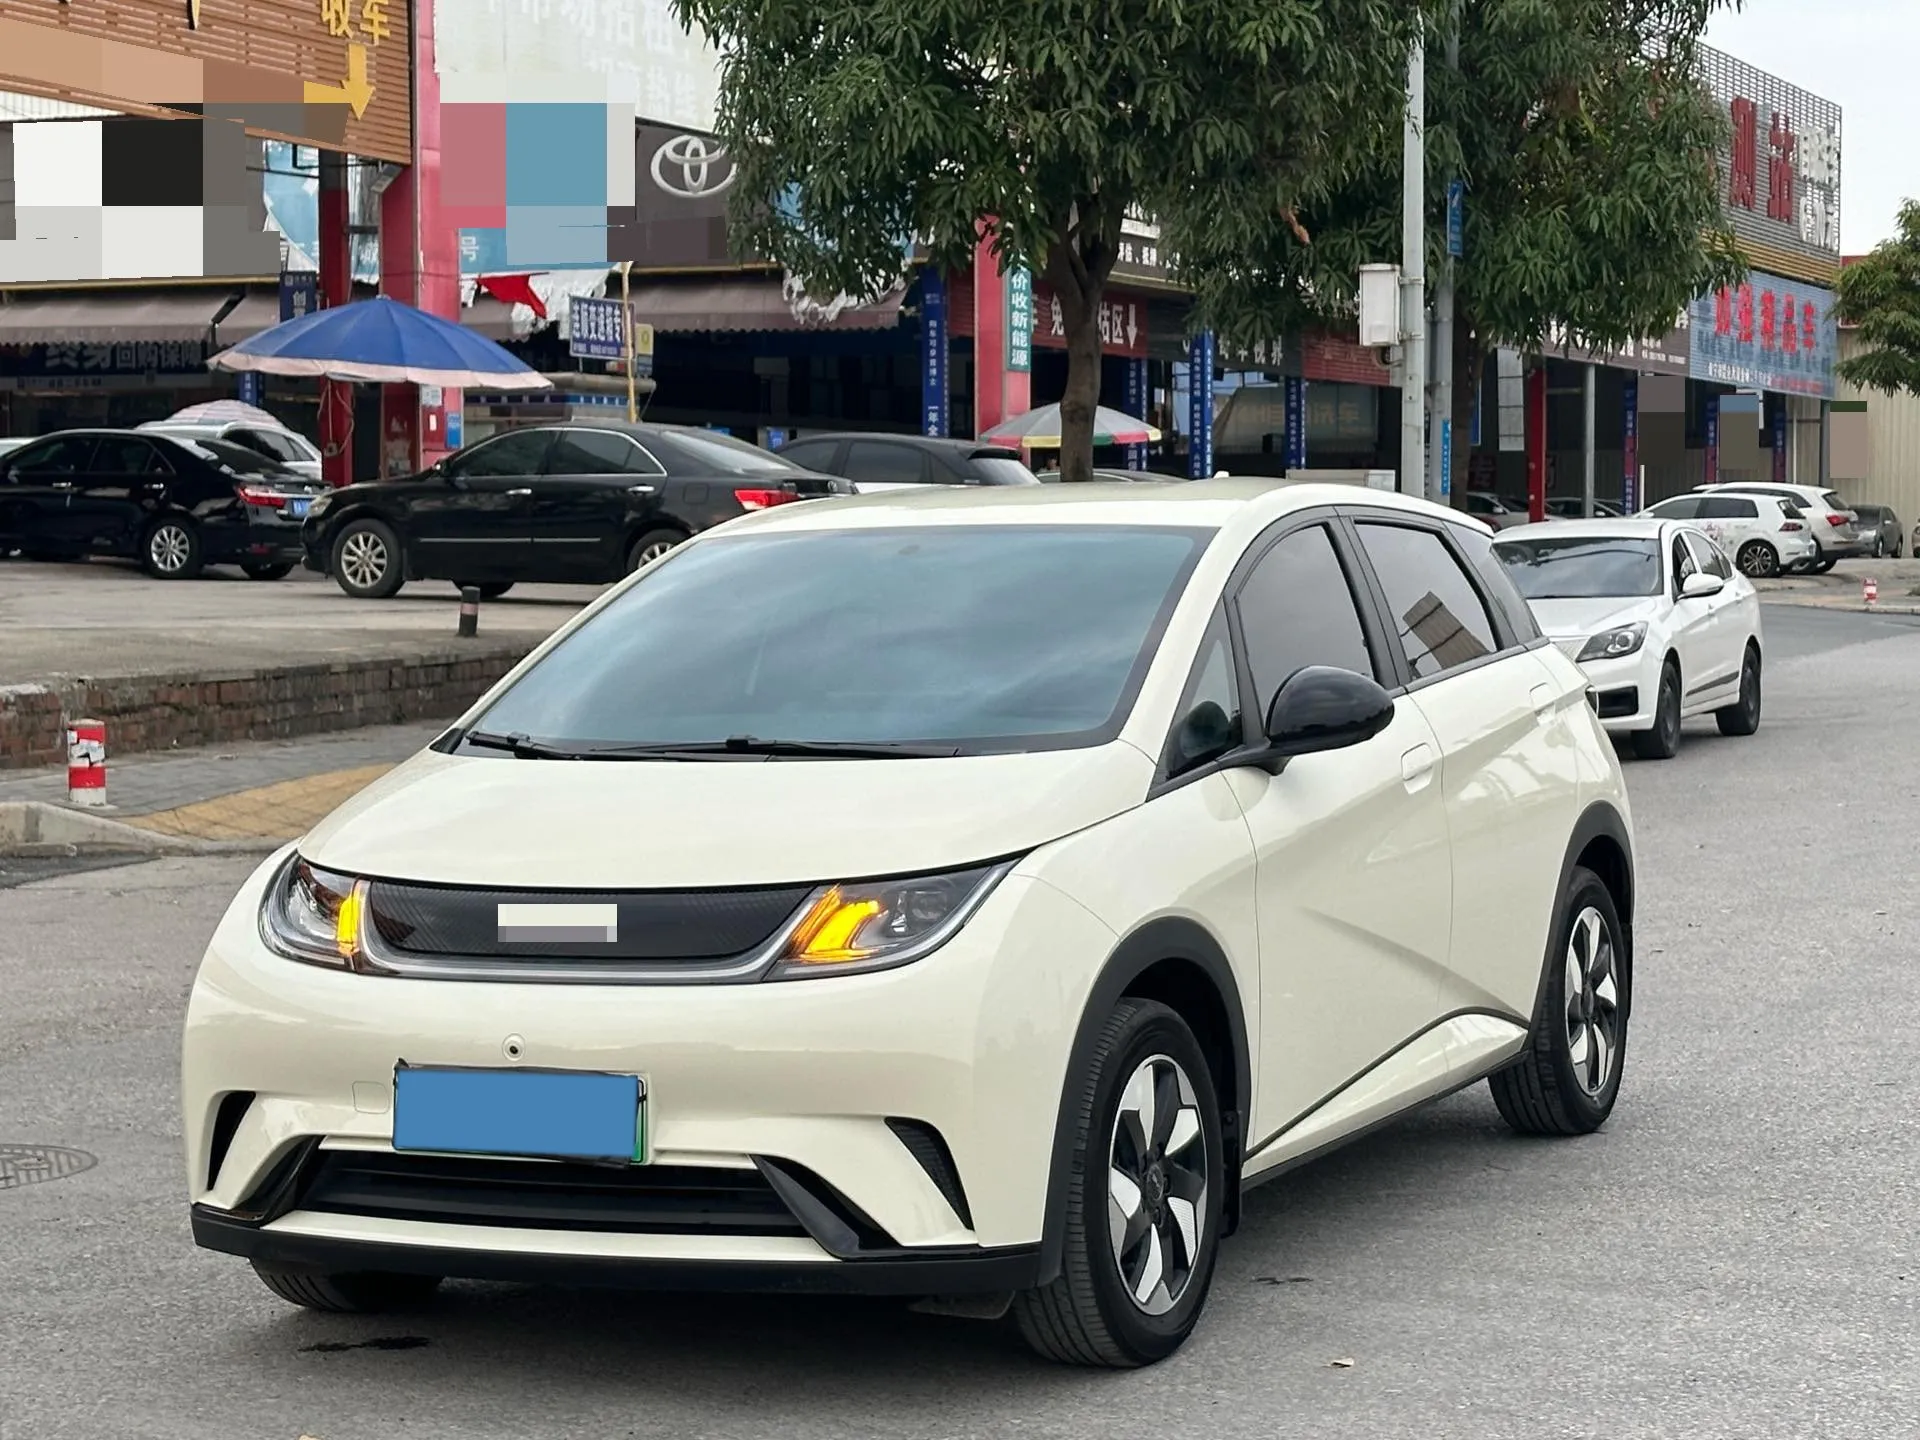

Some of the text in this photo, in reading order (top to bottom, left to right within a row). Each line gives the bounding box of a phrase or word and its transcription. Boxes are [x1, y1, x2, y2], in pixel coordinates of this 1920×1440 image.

[321, 0, 391, 46] 收车
[1011, 271, 1029, 367] 价收新能源
